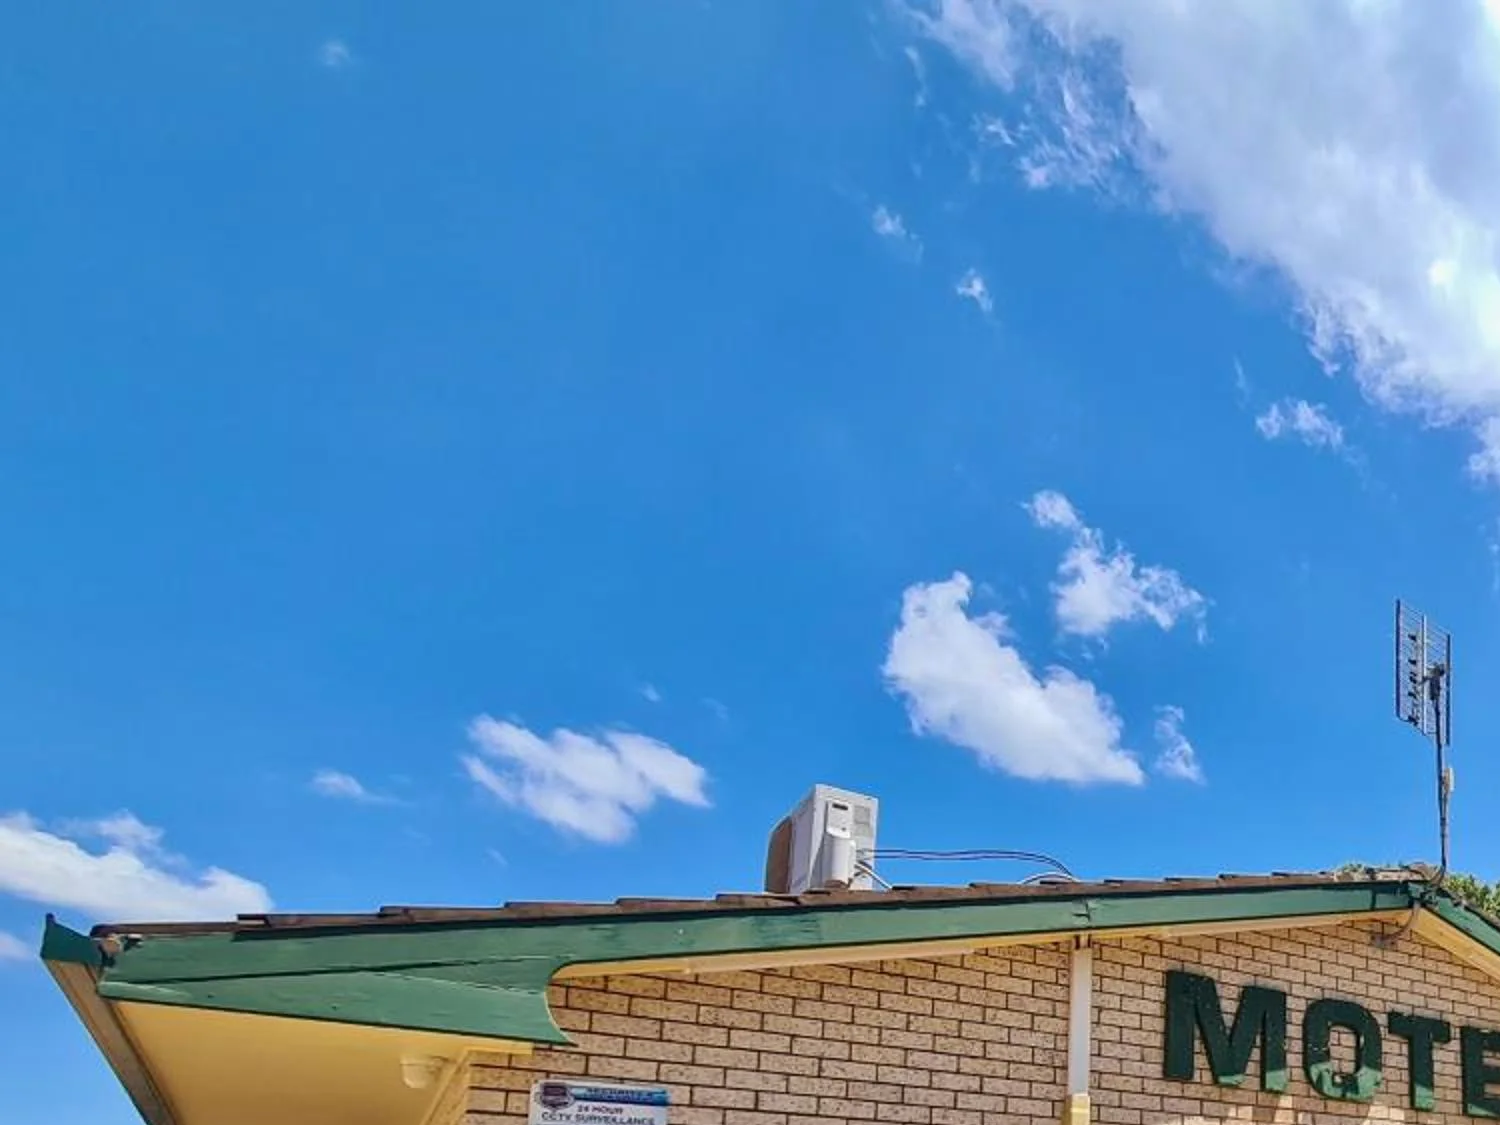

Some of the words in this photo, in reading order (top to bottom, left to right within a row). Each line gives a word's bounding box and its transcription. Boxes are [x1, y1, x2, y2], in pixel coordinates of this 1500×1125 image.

[592, 1105, 624, 1114] HOUR
[541, 1111, 571, 1121] CCTV
[575, 1113, 655, 1125] SURVEILLANCE
